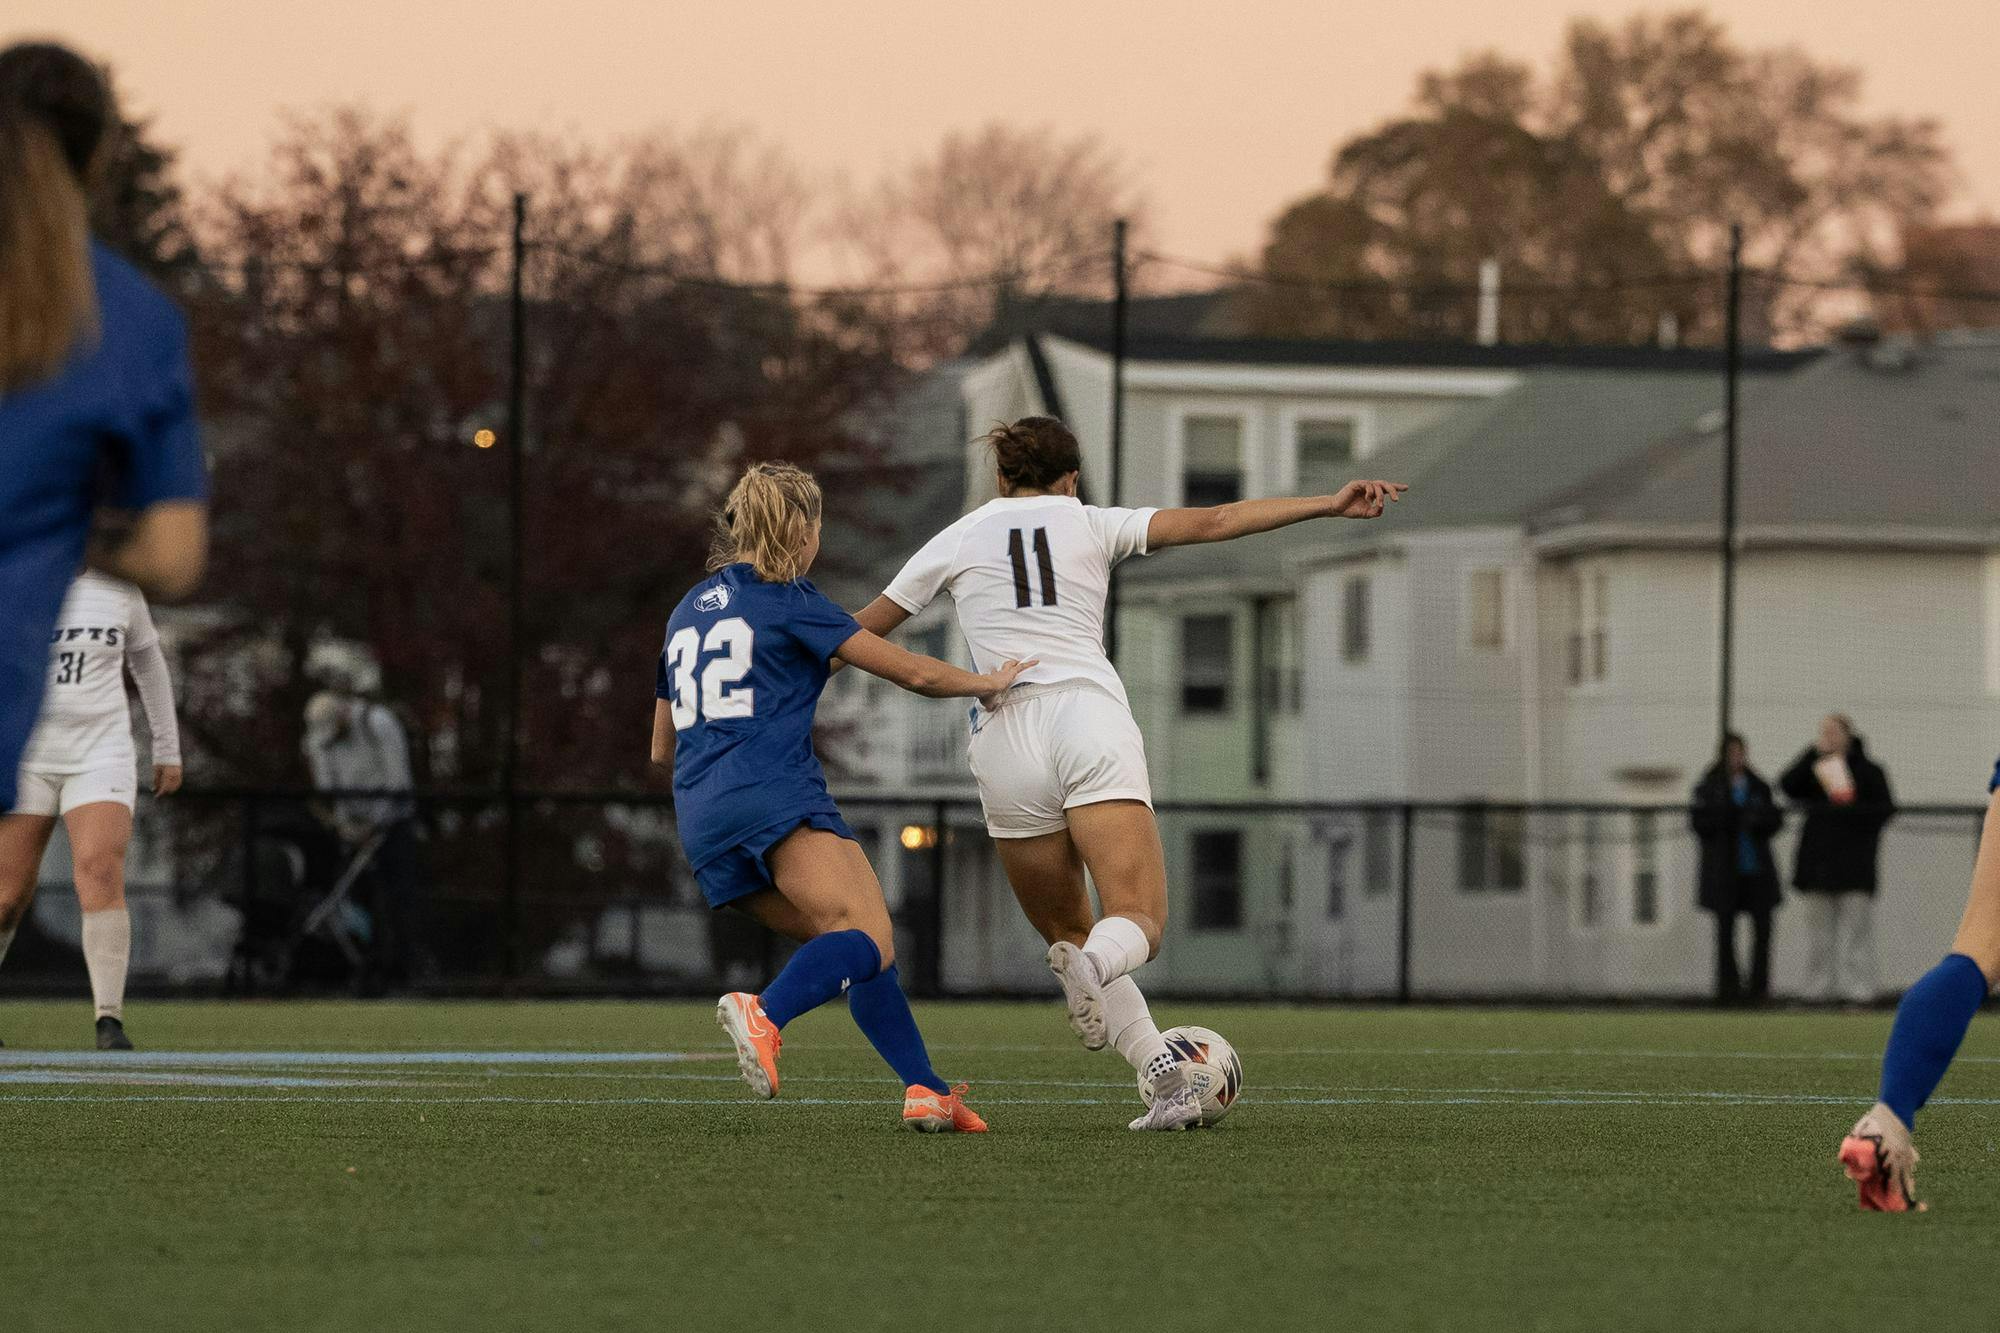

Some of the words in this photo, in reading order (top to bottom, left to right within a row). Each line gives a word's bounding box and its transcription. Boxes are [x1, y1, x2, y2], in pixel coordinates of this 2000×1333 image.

[1007, 526, 1058, 609] 11
[56, 651, 85, 684] 31
[667, 616, 754, 731] 32
